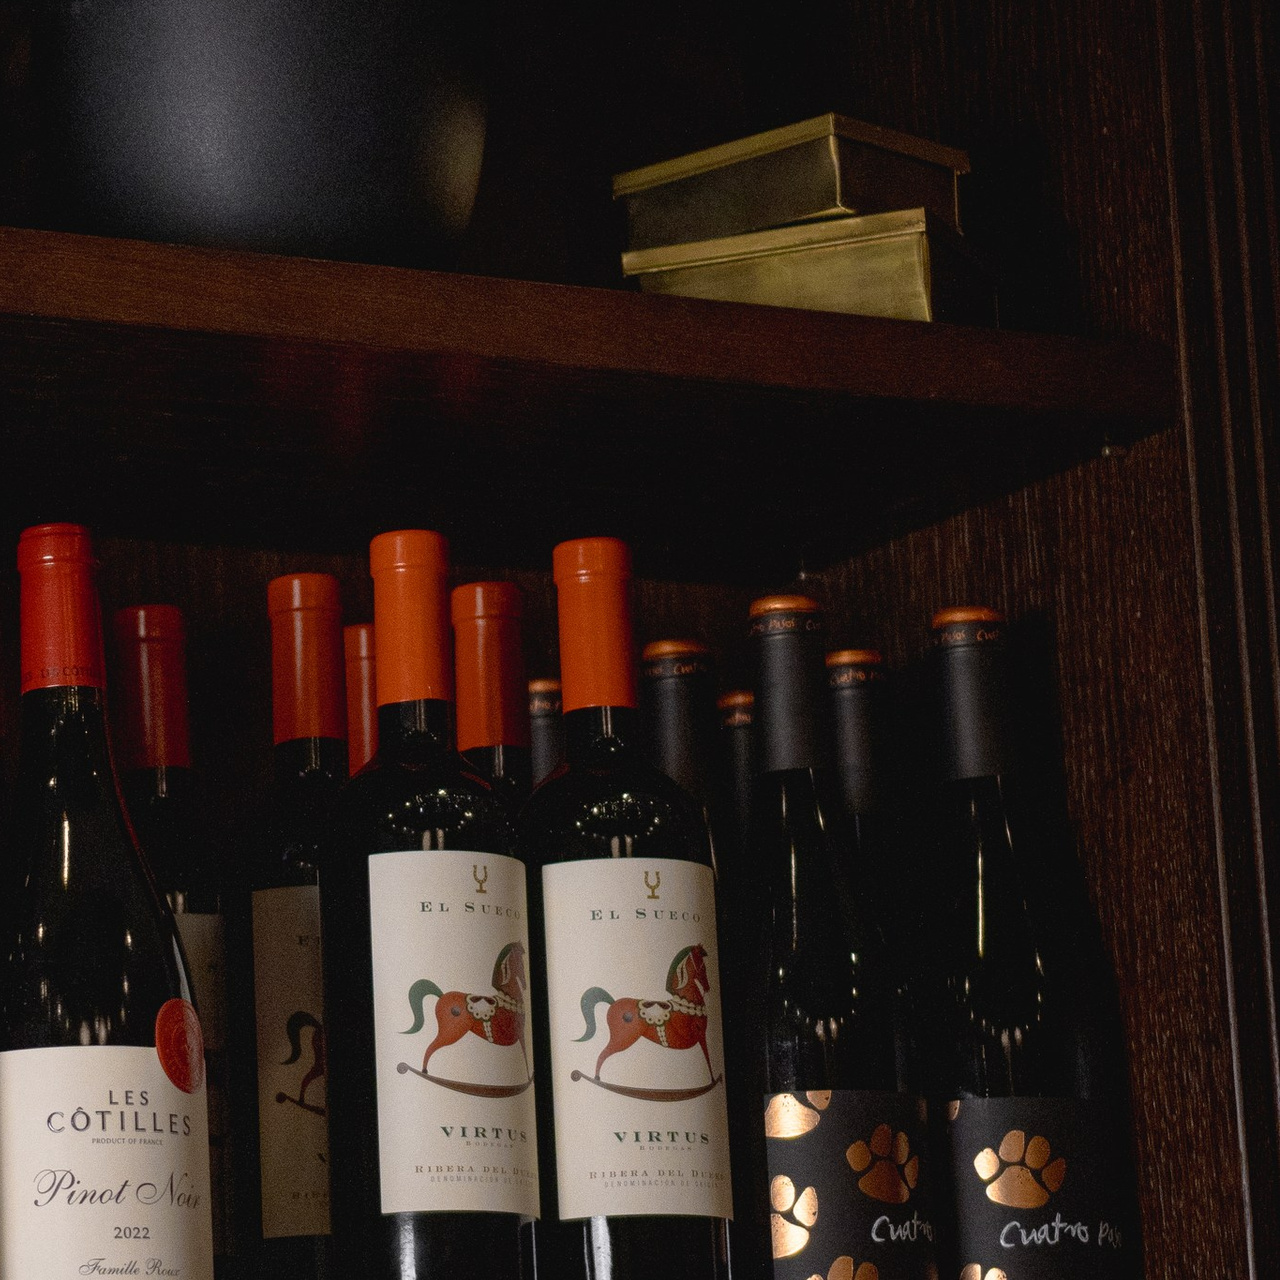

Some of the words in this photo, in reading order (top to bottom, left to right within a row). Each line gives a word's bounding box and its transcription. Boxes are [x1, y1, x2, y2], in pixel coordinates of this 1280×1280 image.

[420, 901, 449, 913] EL
[590, 909, 620, 921] EL
[108, 1090, 149, 1106] LES
[46, 1106, 191, 1137] CÔTILLES
[440, 1126, 527, 1141] VIRTUS
[613, 1130, 710, 1145] VIRTUS
[91, 1137, 125, 1145] PRODUCT
[138, 1138, 163, 1146] FRANCE
[415, 1165, 475, 1174] RIBERA
[483, 1166, 507, 1174] DEL
[589, 1170, 649, 1179] RIBERA
[658, 1169, 684, 1177] DEL
[33, 1168, 131, 1207] Pinot
[135, 1171, 201, 1209] Noir
[113, 1226, 151, 1239] 2022
[1000, 1211, 1090, 1248] Cuatro
[77, 1258, 141, 1276] Famille
